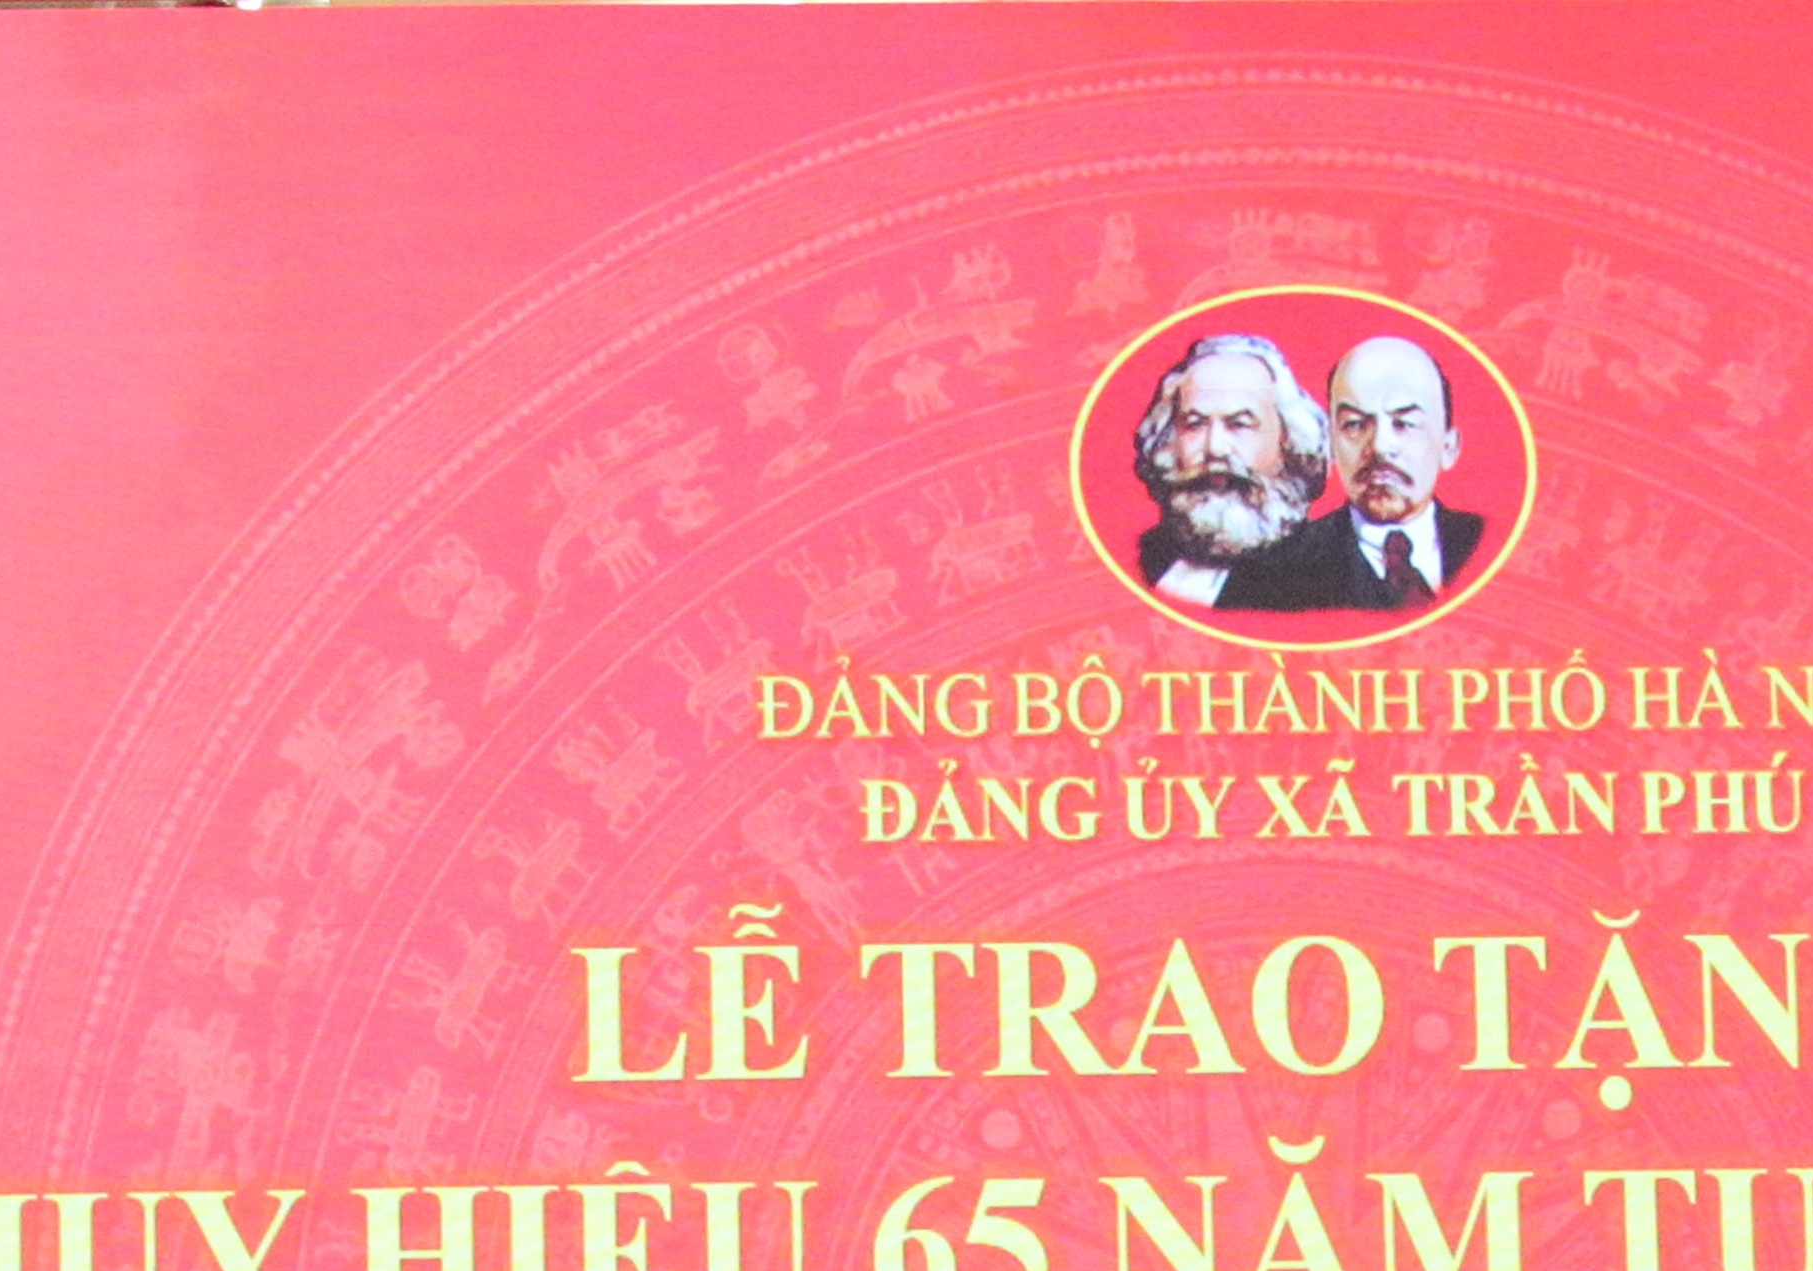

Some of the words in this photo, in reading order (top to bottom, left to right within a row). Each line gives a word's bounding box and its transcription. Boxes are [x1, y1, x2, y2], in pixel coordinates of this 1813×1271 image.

[755, 654, 994, 739] ĐẢNG
[1011, 654, 1124, 749] BỘ
[1140, 649, 1425, 735] THÀNH
[1445, 648, 1606, 732] PHỐ
[1627, 649, 1744, 730] HÀ
[857, 758, 1102, 842] ĐẢNG
[1120, 757, 1236, 841] ỦY
[1255, 757, 1372, 839] XÃ
[1391, 752, 1618, 836] TRẦN
[1640, 750, 1804, 834] PHÚ
[569, 903, 810, 1082] LỄ
[859, 935, 1386, 1078] TRAO
